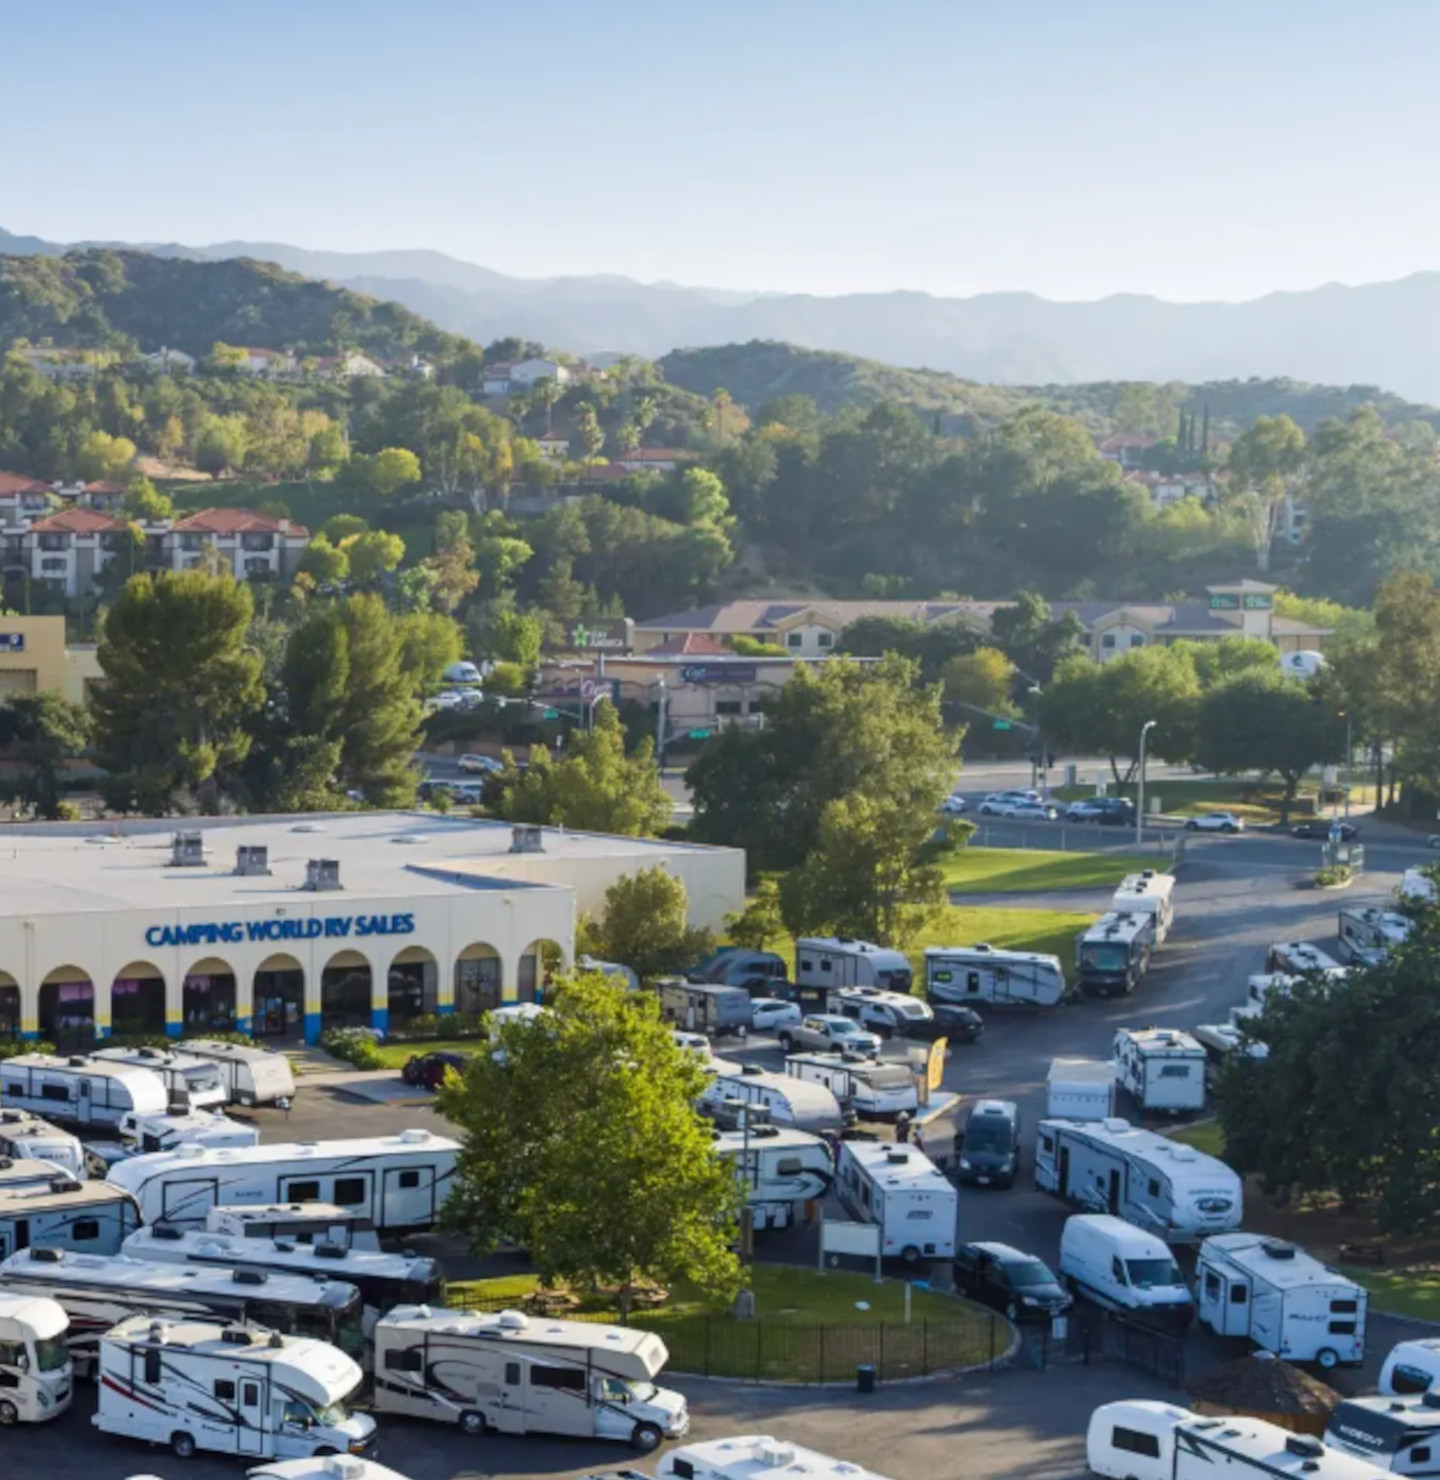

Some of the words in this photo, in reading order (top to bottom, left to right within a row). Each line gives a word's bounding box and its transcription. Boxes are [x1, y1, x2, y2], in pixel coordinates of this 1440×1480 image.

[145, 922, 243, 947] CAMPING
[244, 917, 323, 941] WORLD
[324, 916, 353, 937] RV
[354, 913, 414, 936] SALES
